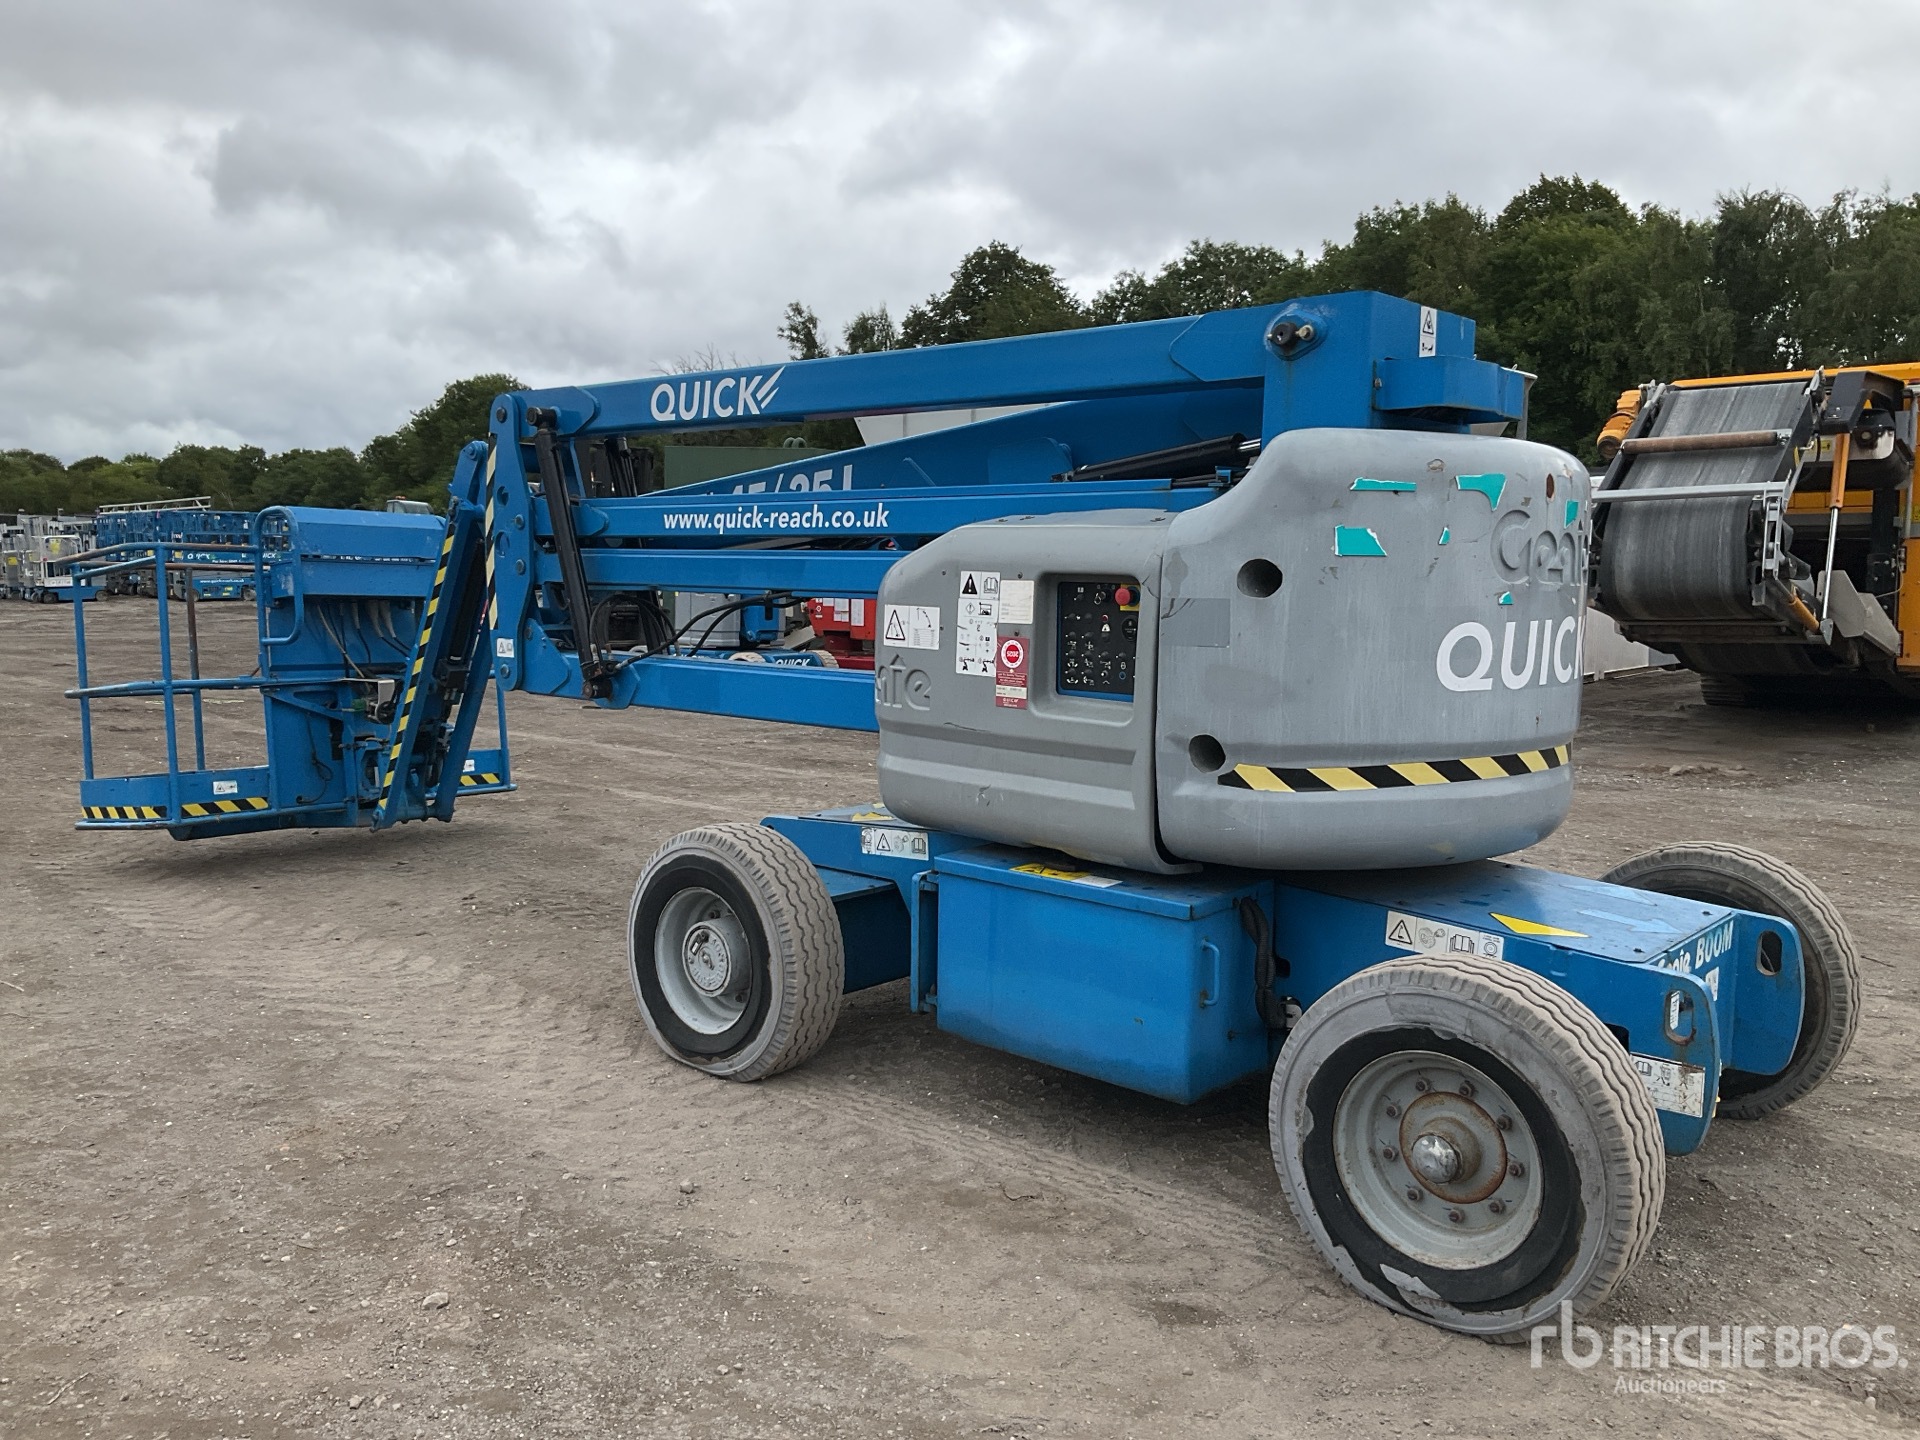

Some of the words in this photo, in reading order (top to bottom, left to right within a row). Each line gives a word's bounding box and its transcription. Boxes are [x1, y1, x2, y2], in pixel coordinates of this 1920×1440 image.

[650, 375, 763, 421] QUICK
[663, 502, 890, 535] www.quick-reach.co.uk
[1436, 616, 1586, 692] QUICK
[1695, 920, 1734, 970] BOOM
